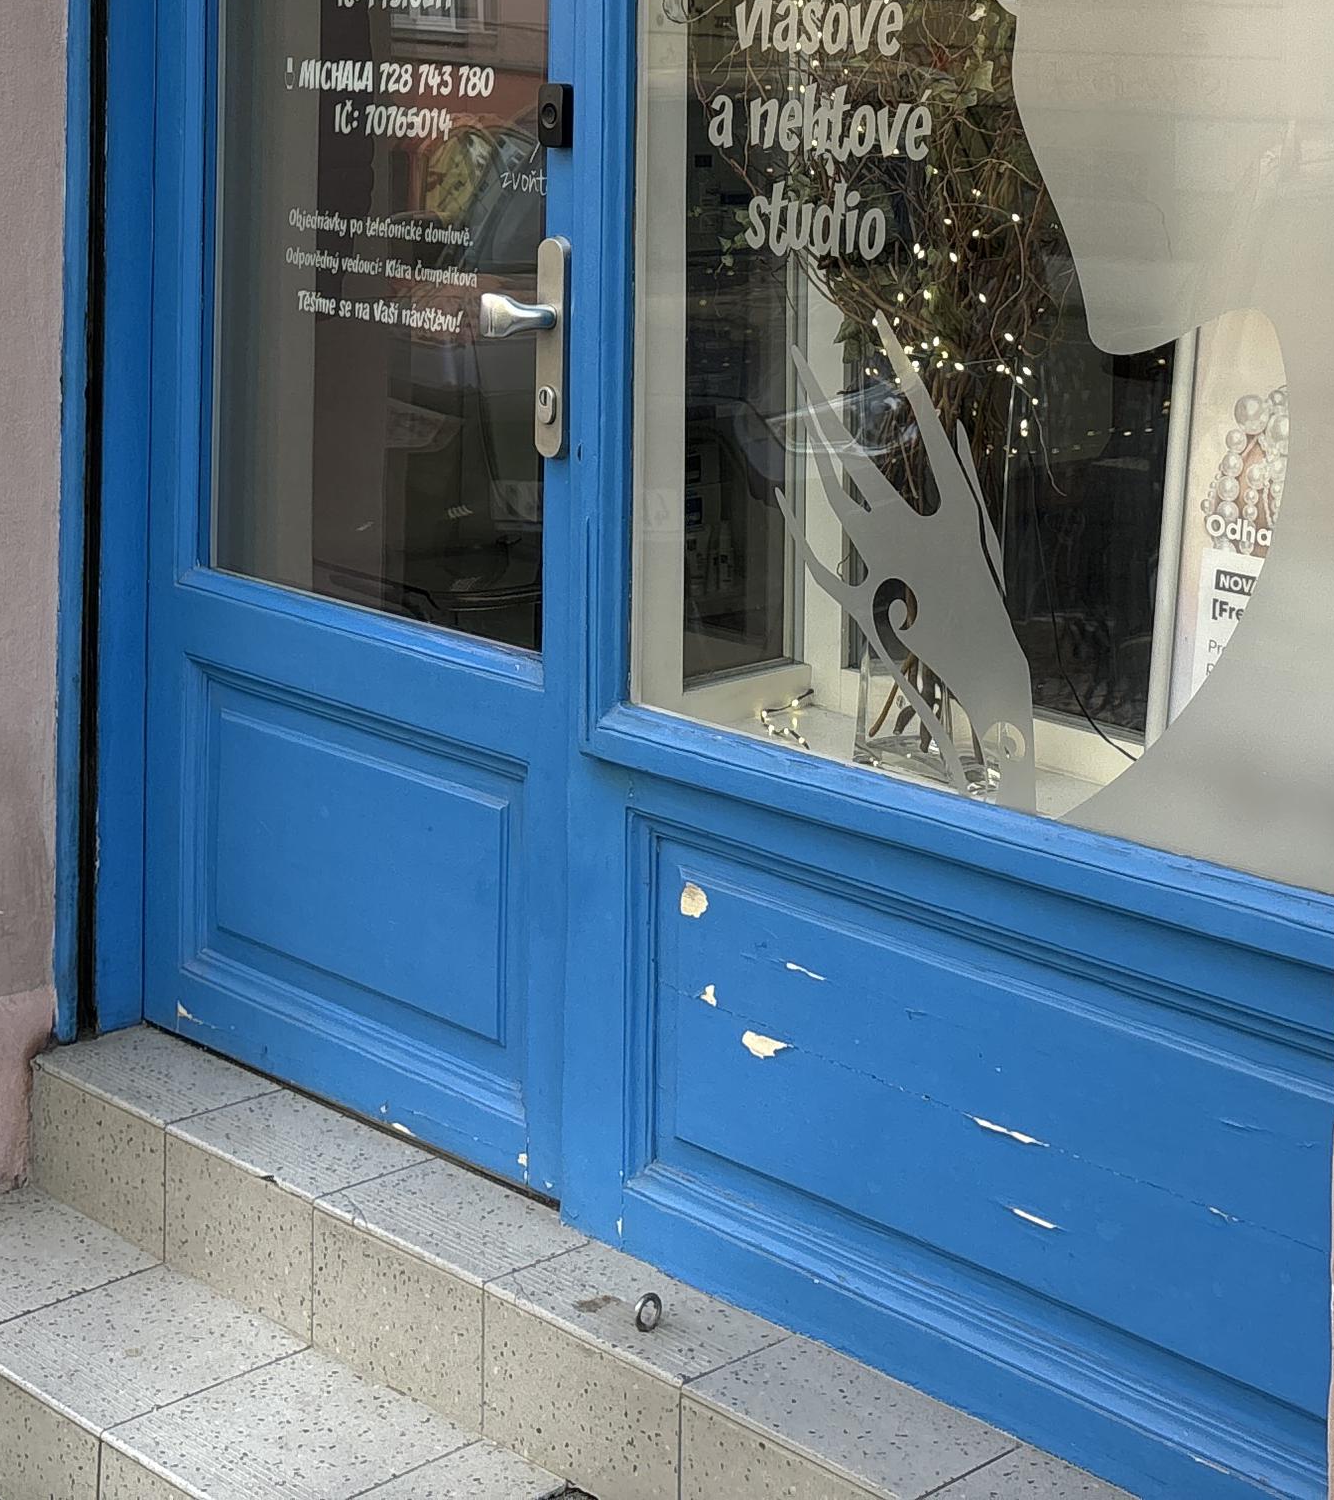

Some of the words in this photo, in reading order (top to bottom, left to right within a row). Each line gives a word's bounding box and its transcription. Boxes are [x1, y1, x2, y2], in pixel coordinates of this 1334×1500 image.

[298, 57, 374, 93] MICHALA
[379, 63, 413, 94] 728
[418, 64, 453, 97] 743
[459, 66, 495, 98] 780
[334, 99, 359, 135] IČ:
[365, 104, 453, 141] 70765014
[708, 95, 734, 150] a
[750, 82, 932, 162] nehtové
[289, 208, 347, 237] Objednávky
[350, 218, 363, 238] po
[365, 216, 422, 242] telefonické
[425, 222, 474, 248] domluvě.
[744, 180, 886, 261] studio
[285, 247, 340, 275] Odpovědný
[341, 254, 382, 276] vedoucí:
[385, 258, 412, 281] Klára
[297, 290, 336, 316] Těšíme
[339, 300, 352, 318] se
[355, 303, 370, 321] na
[373, 299, 399, 325] Vaší
[402, 305, 464, 333] návštěvu!
